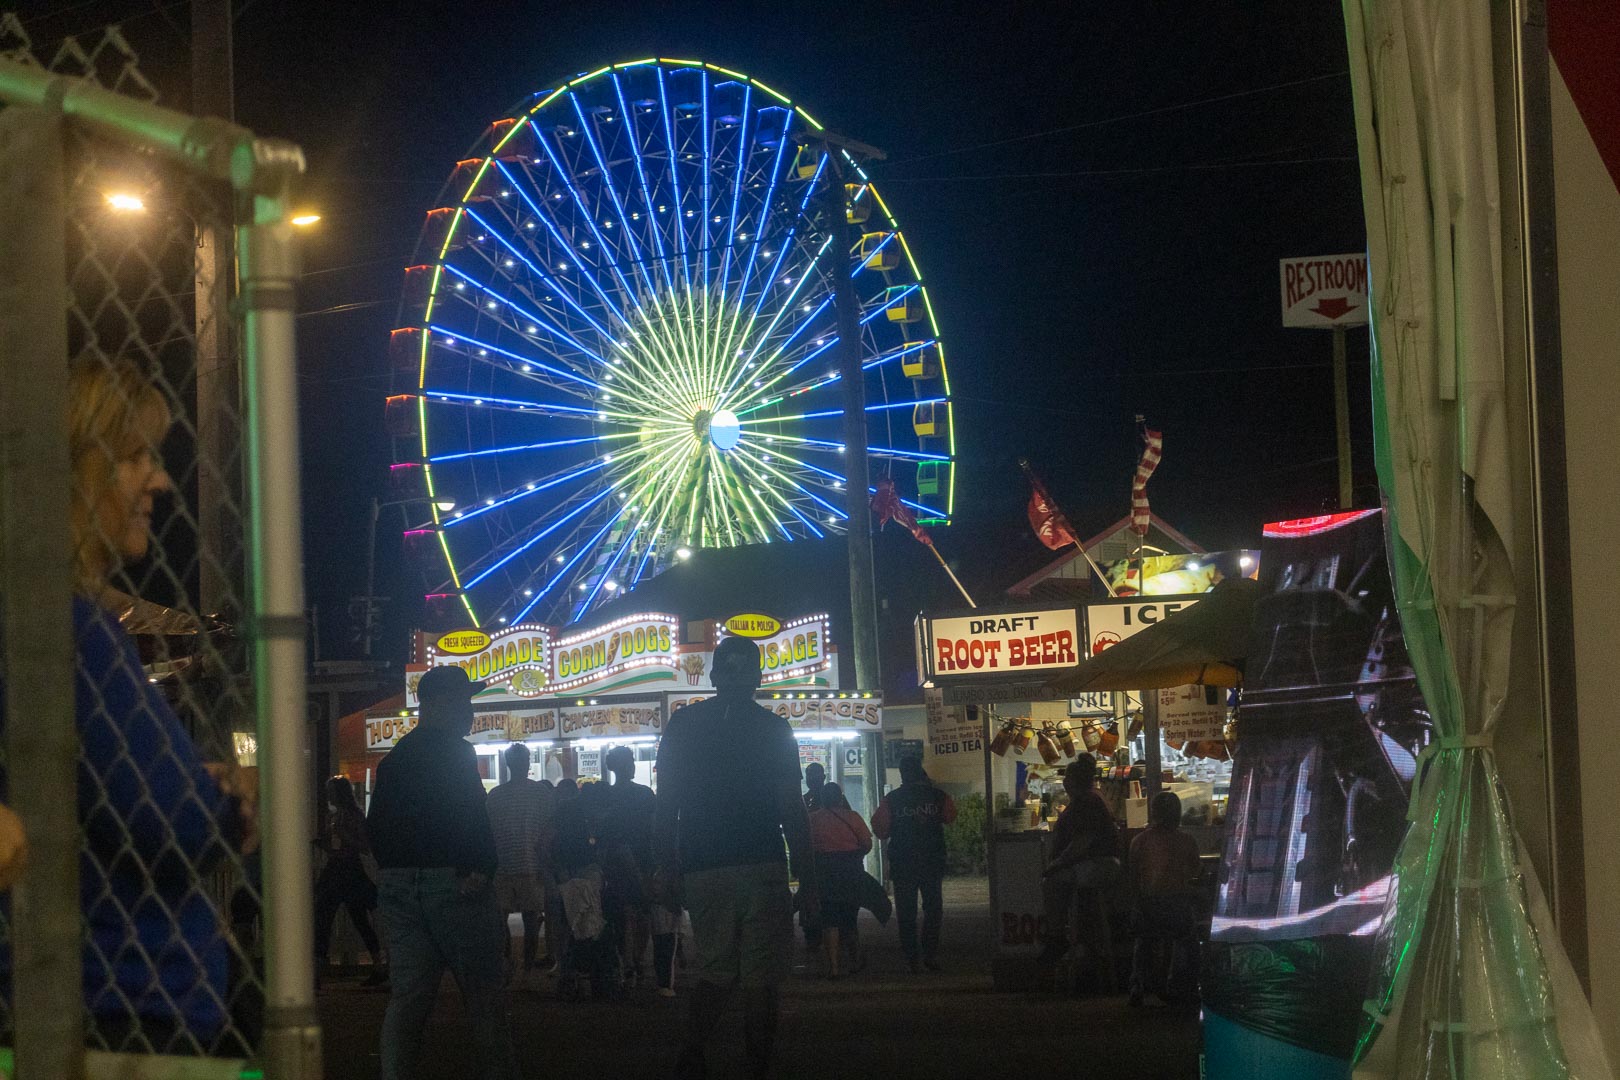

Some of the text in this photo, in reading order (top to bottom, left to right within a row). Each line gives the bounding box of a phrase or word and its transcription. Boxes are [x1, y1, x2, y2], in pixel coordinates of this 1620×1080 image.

[729, 619, 775, 632] ITALIAN & POLISH
[969, 616, 1039, 634] DRAFT
[444, 635, 485, 649] FRESH SQUEEZED
[936, 637, 1002, 671] ROOT
[1008, 629, 1076, 666] BEER
[438, 637, 544, 682] MONADE
[558, 625, 671, 678] CORN DOGS
[471, 710, 556, 735] RENCH FRIES
[1159, 720, 1172, 728] Any
[1166, 729, 1186, 740] Spring
[1186, 728, 1206, 738] Water
[934, 739, 982, 755] ICED TEA
